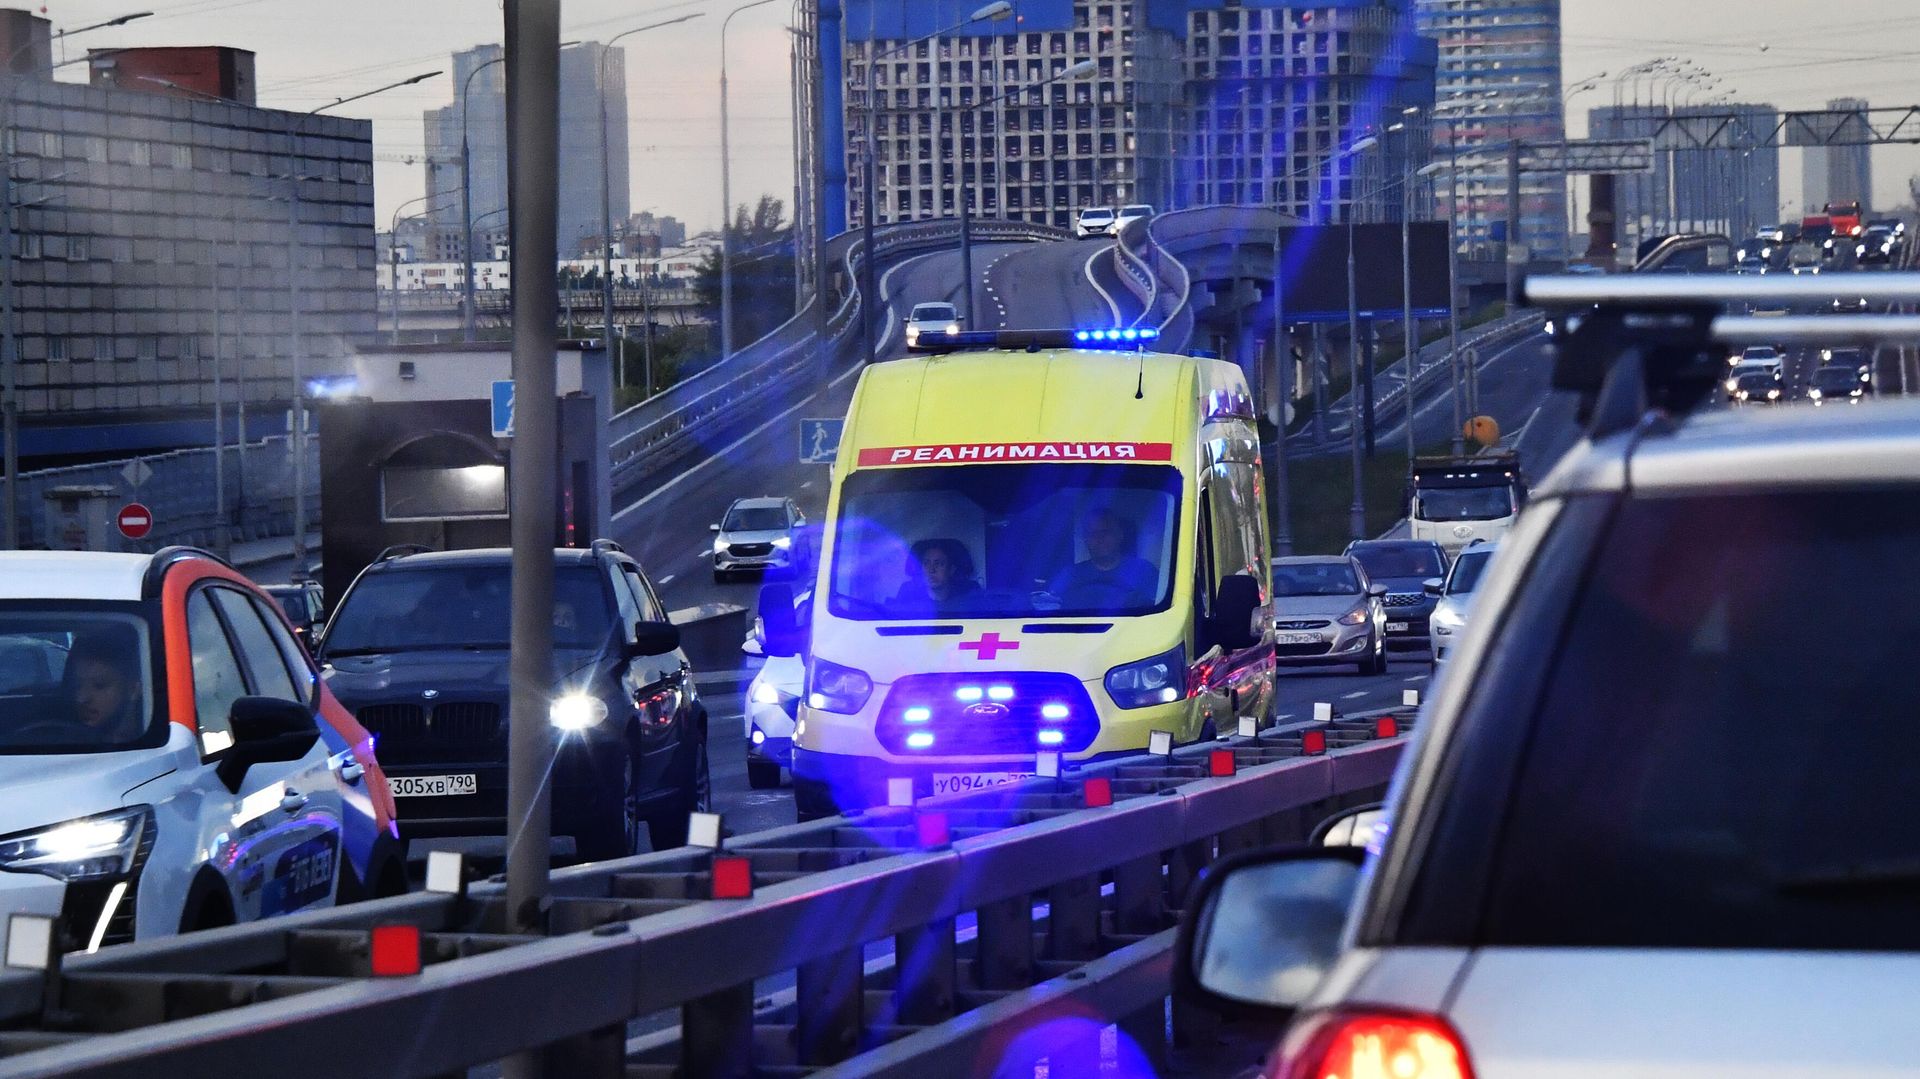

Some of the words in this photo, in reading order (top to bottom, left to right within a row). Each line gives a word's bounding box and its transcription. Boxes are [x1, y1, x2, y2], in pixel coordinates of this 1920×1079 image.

[890, 445, 1136, 462] РЕАНИМАЦИЯ
[388, 778, 445, 795] 305ХВ
[448, 775, 472, 788] 790
